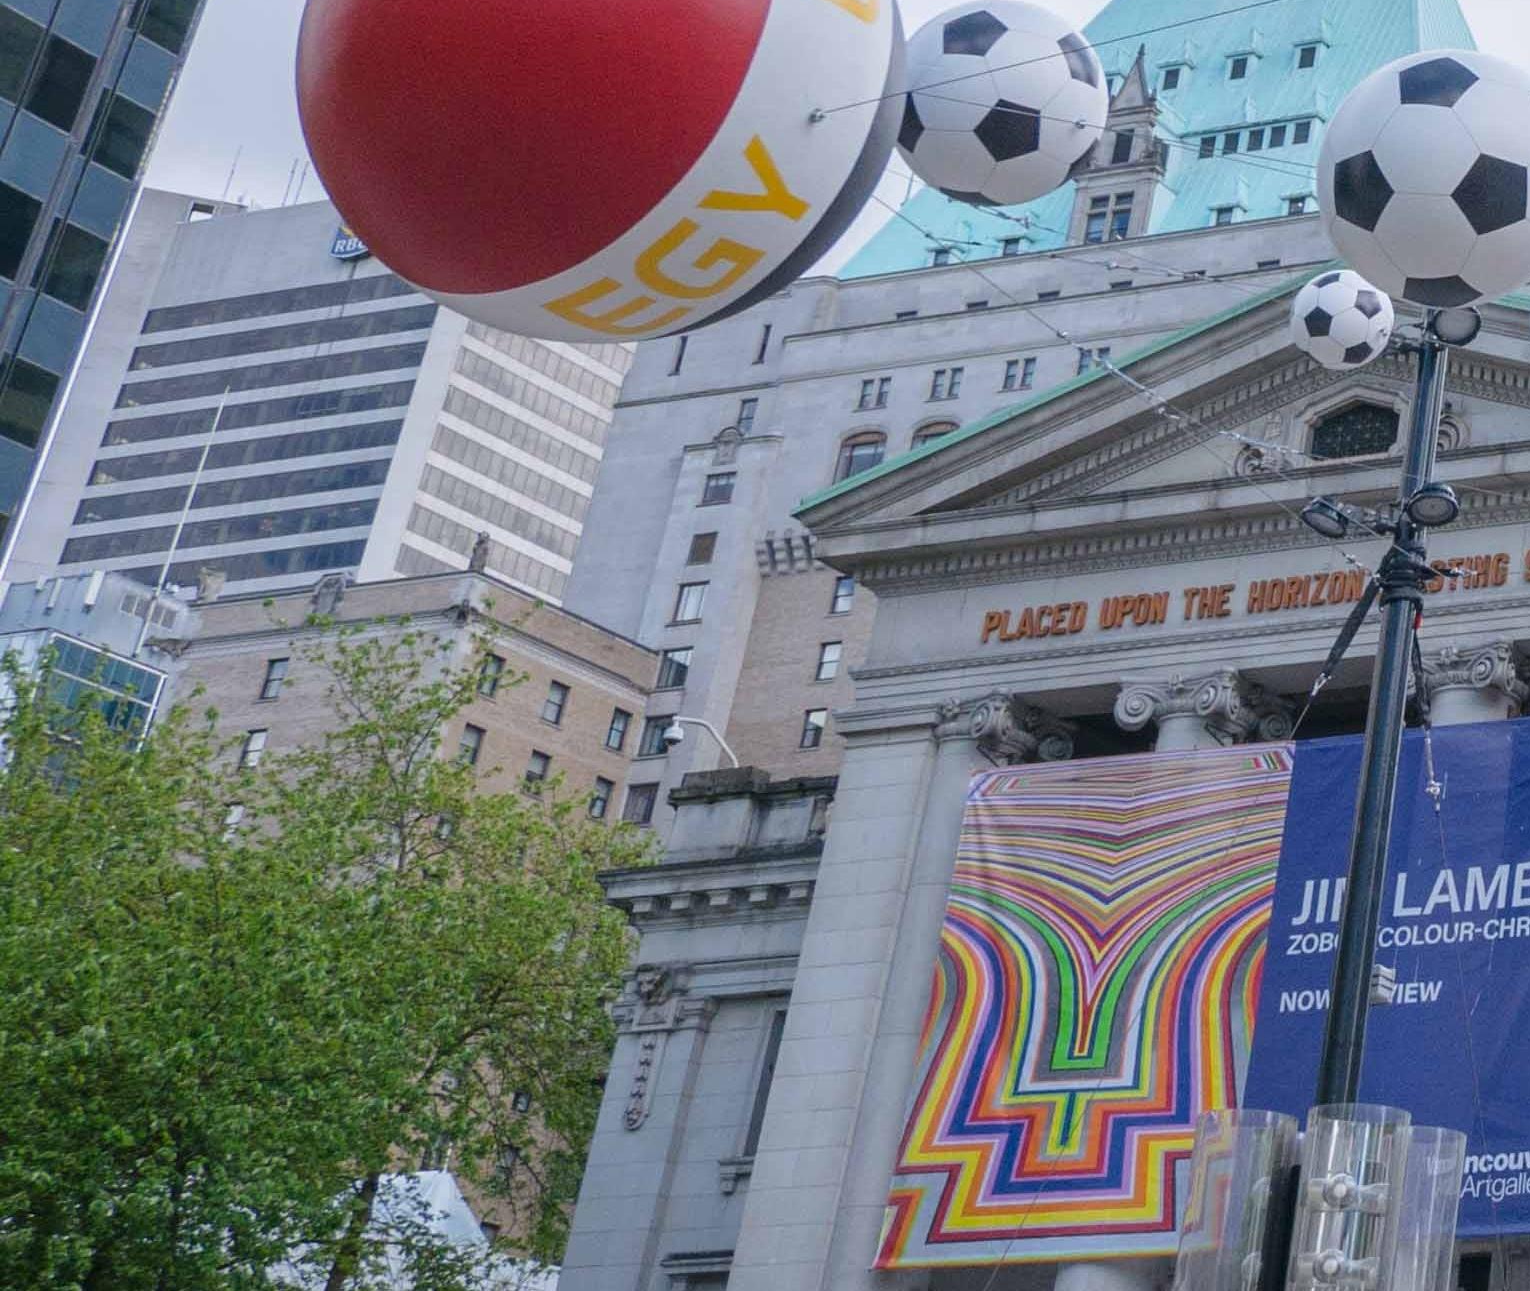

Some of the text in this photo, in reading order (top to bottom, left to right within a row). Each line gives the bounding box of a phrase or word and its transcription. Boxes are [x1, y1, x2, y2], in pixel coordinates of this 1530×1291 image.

[541, 133, 811, 337] EGY
[980, 600, 1089, 644] PLACED
[1098, 590, 1170, 630] UPON
[1183, 583, 1235, 621] THE
[1247, 568, 1368, 615] HORIZON
